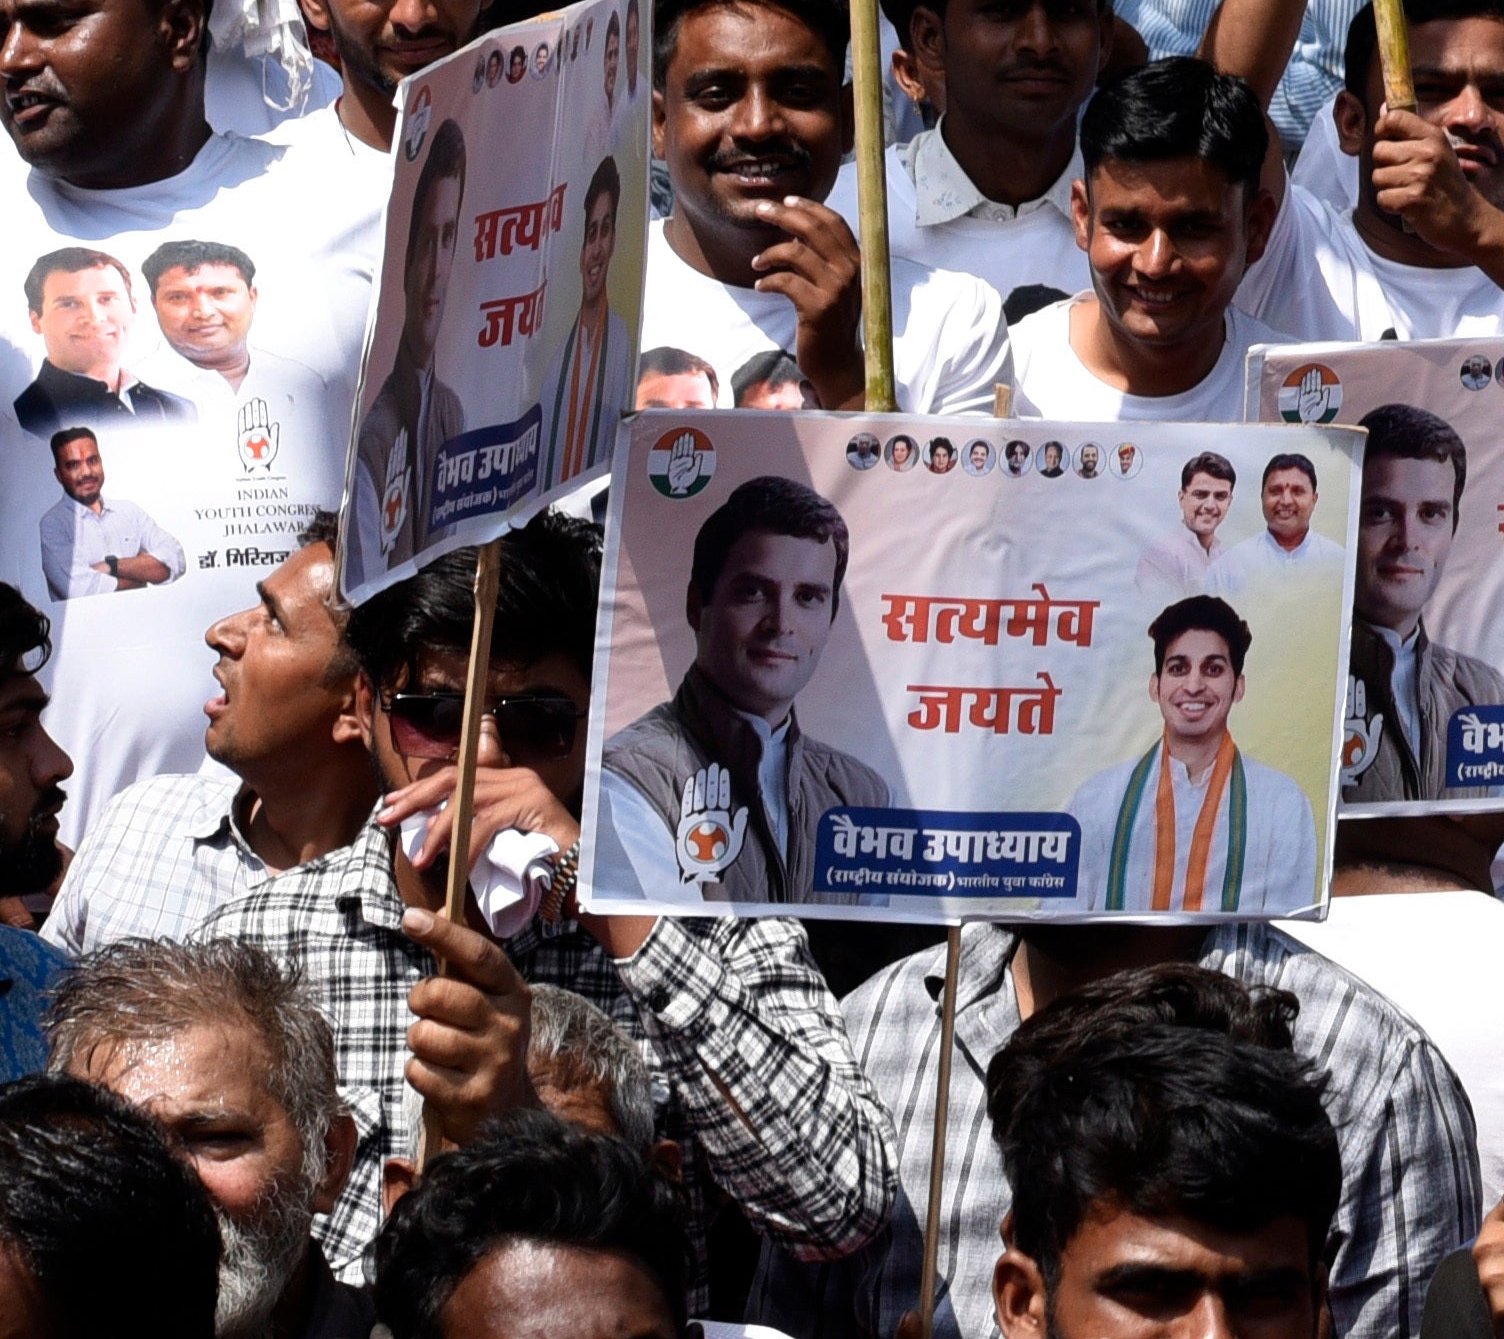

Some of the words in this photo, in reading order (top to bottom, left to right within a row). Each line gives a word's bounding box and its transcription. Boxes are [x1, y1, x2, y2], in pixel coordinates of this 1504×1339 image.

[237, 487, 289, 501] INDIAN
[437, 449, 478, 494] वैभव
[194, 506, 252, 521] YOUTH
[880, 583, 1101, 648] सत्यमेव
[906, 672, 1062, 736] जयते
[828, 814, 918, 861] वैभव
[922, 828, 1072, 864] उपाध्याय
